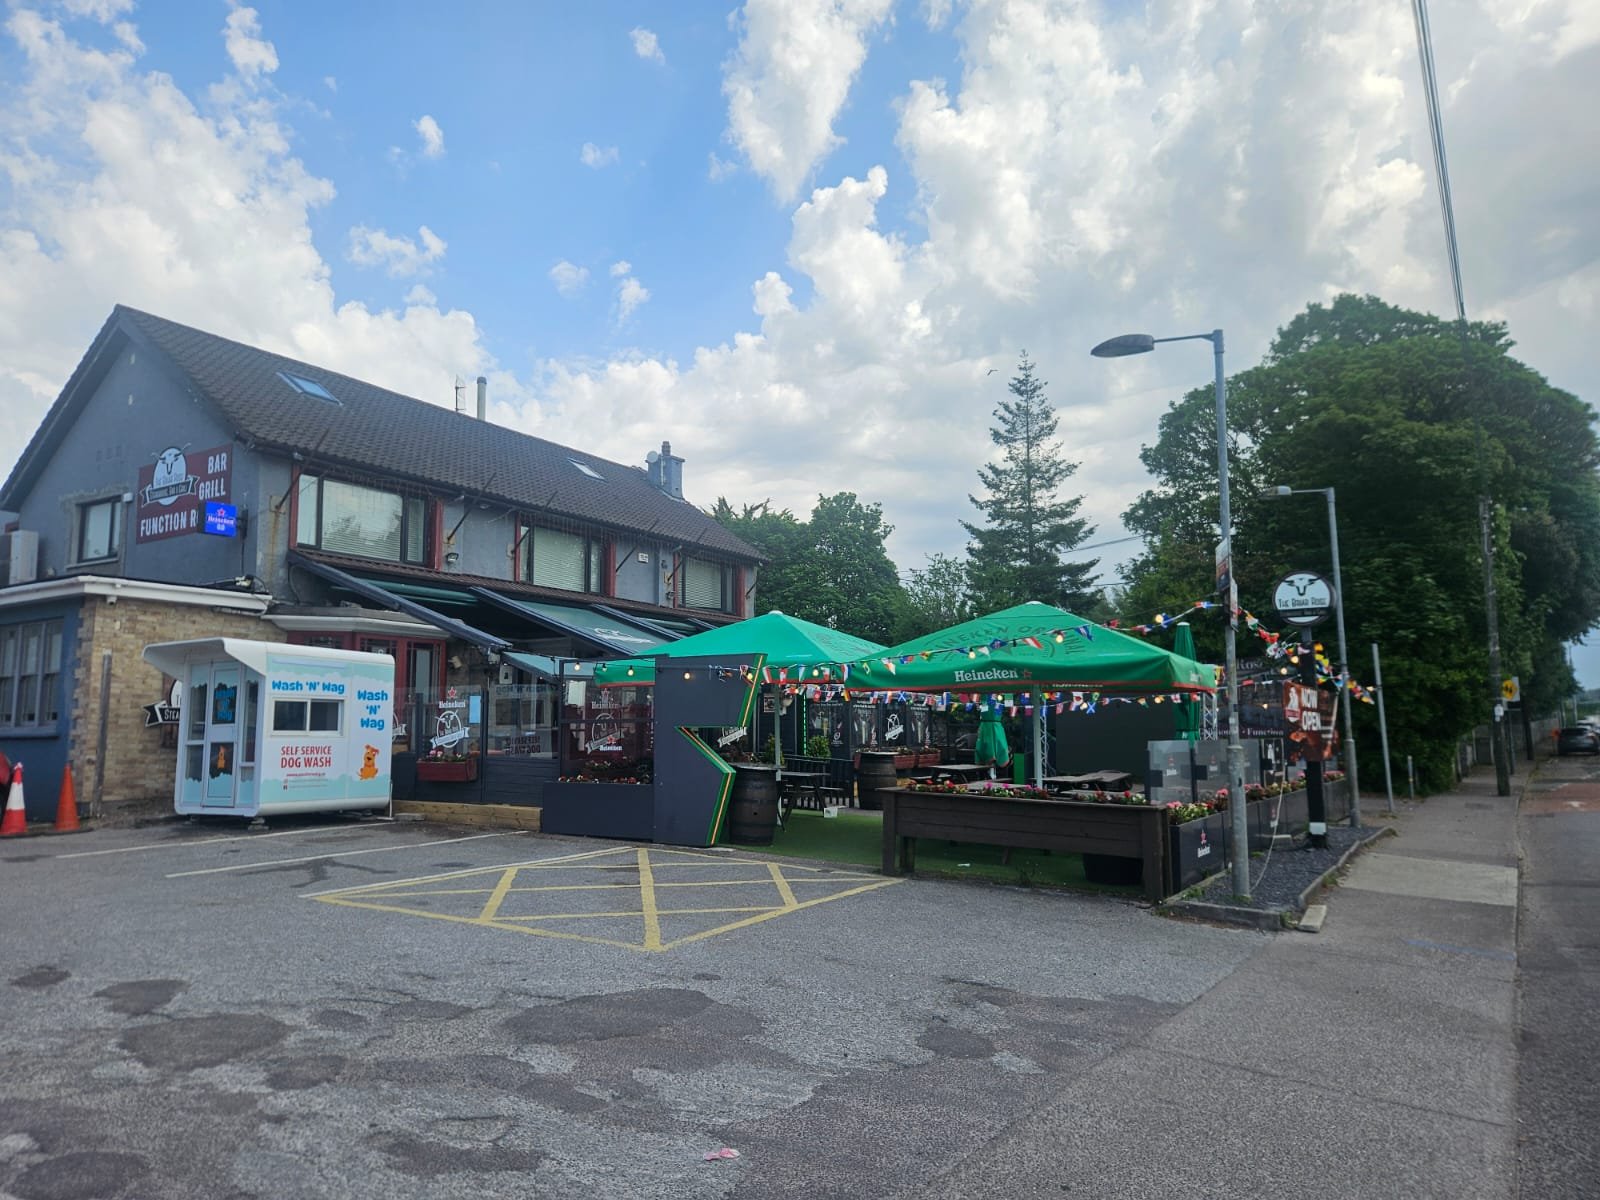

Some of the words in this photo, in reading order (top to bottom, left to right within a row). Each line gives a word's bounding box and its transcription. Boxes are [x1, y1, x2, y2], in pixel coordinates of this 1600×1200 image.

[208, 452, 228, 474] BAR
[199, 478, 226, 500] GRILL
[140, 513, 187, 537] FUNCTION
[954, 668, 1018, 682] Heineken
[271, 680, 303, 691] Wash
[322, 682, 345, 695] Wag
[357, 690, 388, 701] Wash
[1300, 687, 1318, 709] NOW
[360, 718, 385, 731] Wag
[1302, 711, 1321, 731] OPEN
[281, 746, 300, 756] SELF
[300, 745, 332, 755] SERVICE
[280, 757, 301, 768] DOG
[303, 756, 332, 768] WASH
